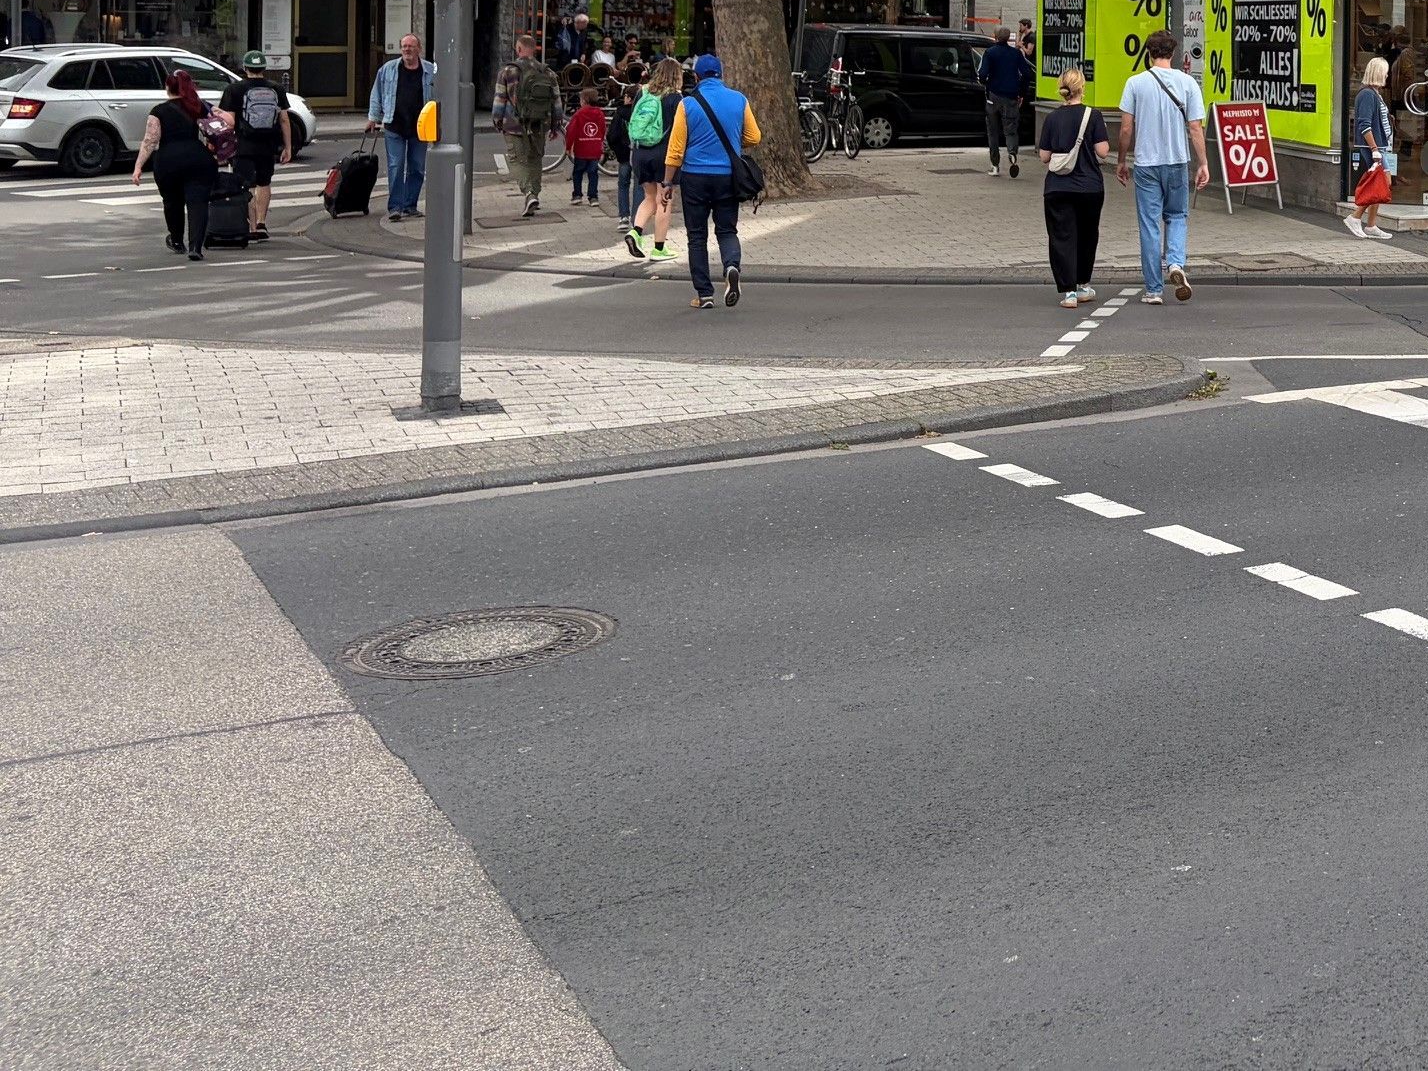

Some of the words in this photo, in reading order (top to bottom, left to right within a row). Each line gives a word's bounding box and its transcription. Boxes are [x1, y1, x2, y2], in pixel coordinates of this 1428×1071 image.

[1045, 13, 1061, 27] 20%
[1066, 13, 1083, 27] 70%
[1234, 5, 1249, 21] WIR
[1250, 4, 1297, 20] SCHLIESSEN!
[1059, 33, 1080, 53] ALLES
[1234, 25, 1260, 42] 20%
[1269, 25, 1297, 42] 70%
[1043, 55, 1061, 75] MUSS
[1260, 50, 1291, 76] ALLES
[1233, 78, 1262, 102] MUSS
[1222, 109, 1252, 118] MEPHISTO
[1223, 123, 1266, 142] SALE
[1229, 142, 1269, 180] %
